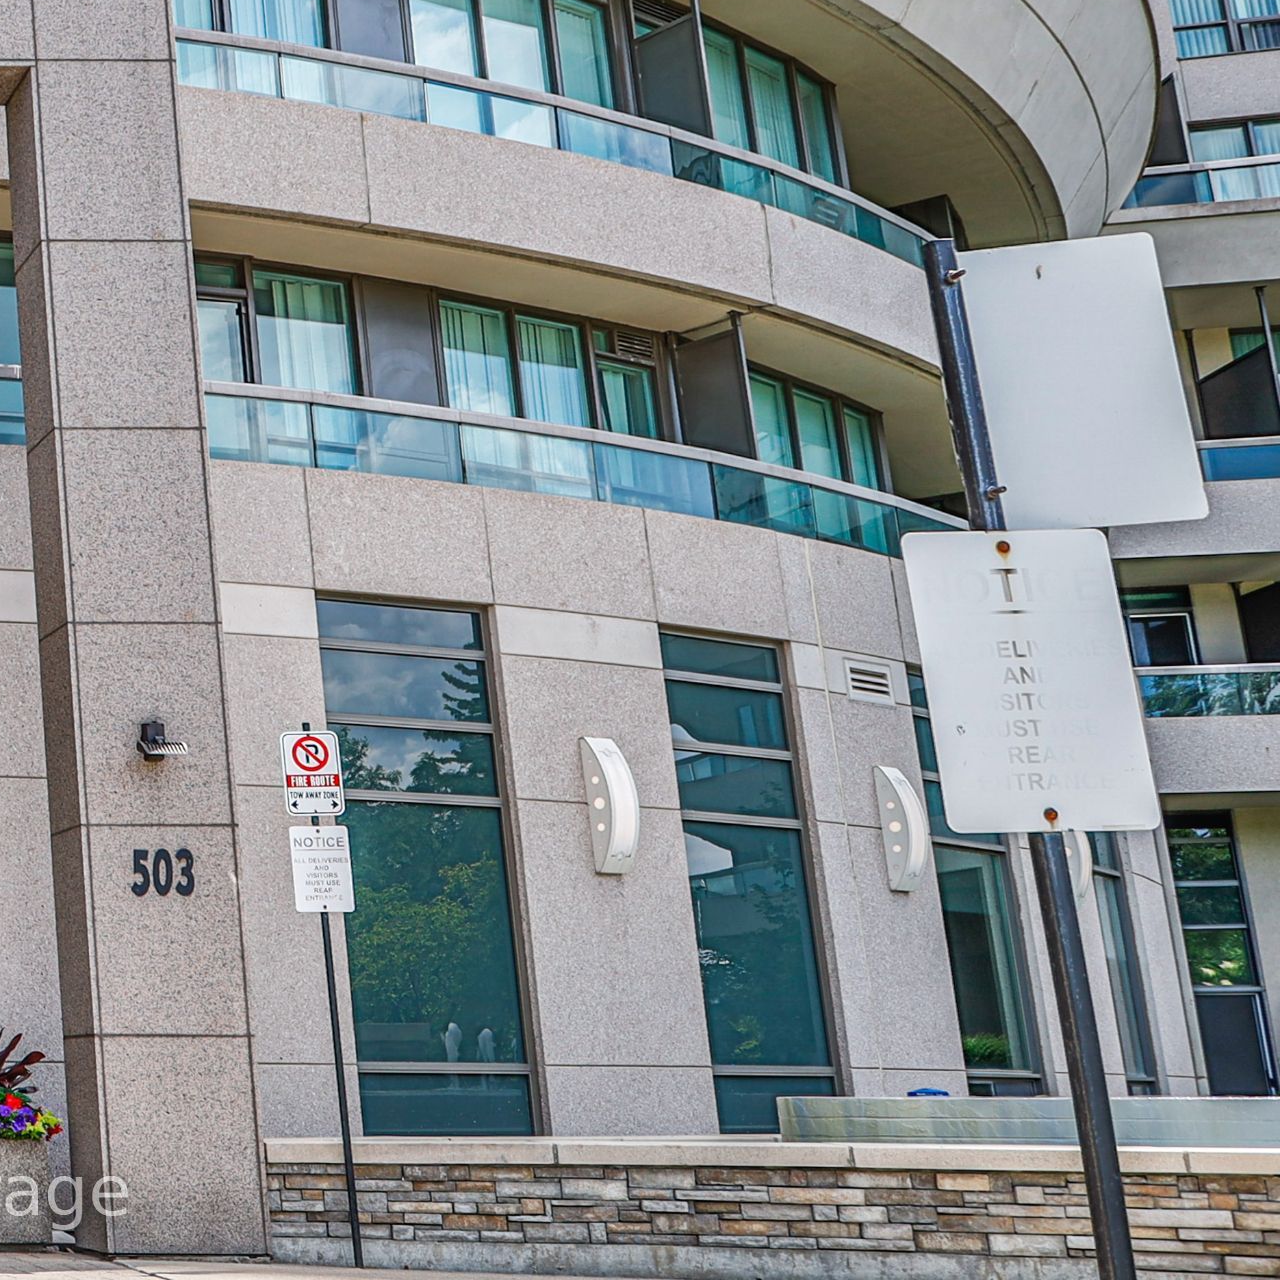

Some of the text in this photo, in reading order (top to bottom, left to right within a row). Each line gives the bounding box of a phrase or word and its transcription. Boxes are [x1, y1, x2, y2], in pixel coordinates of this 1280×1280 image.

[290, 775, 336, 787] FIRE ROUTE
[290, 791, 339, 799] TOW AWAY ZONE
[293, 836, 345, 848] NOTICE
[131, 848, 195, 897] 503
